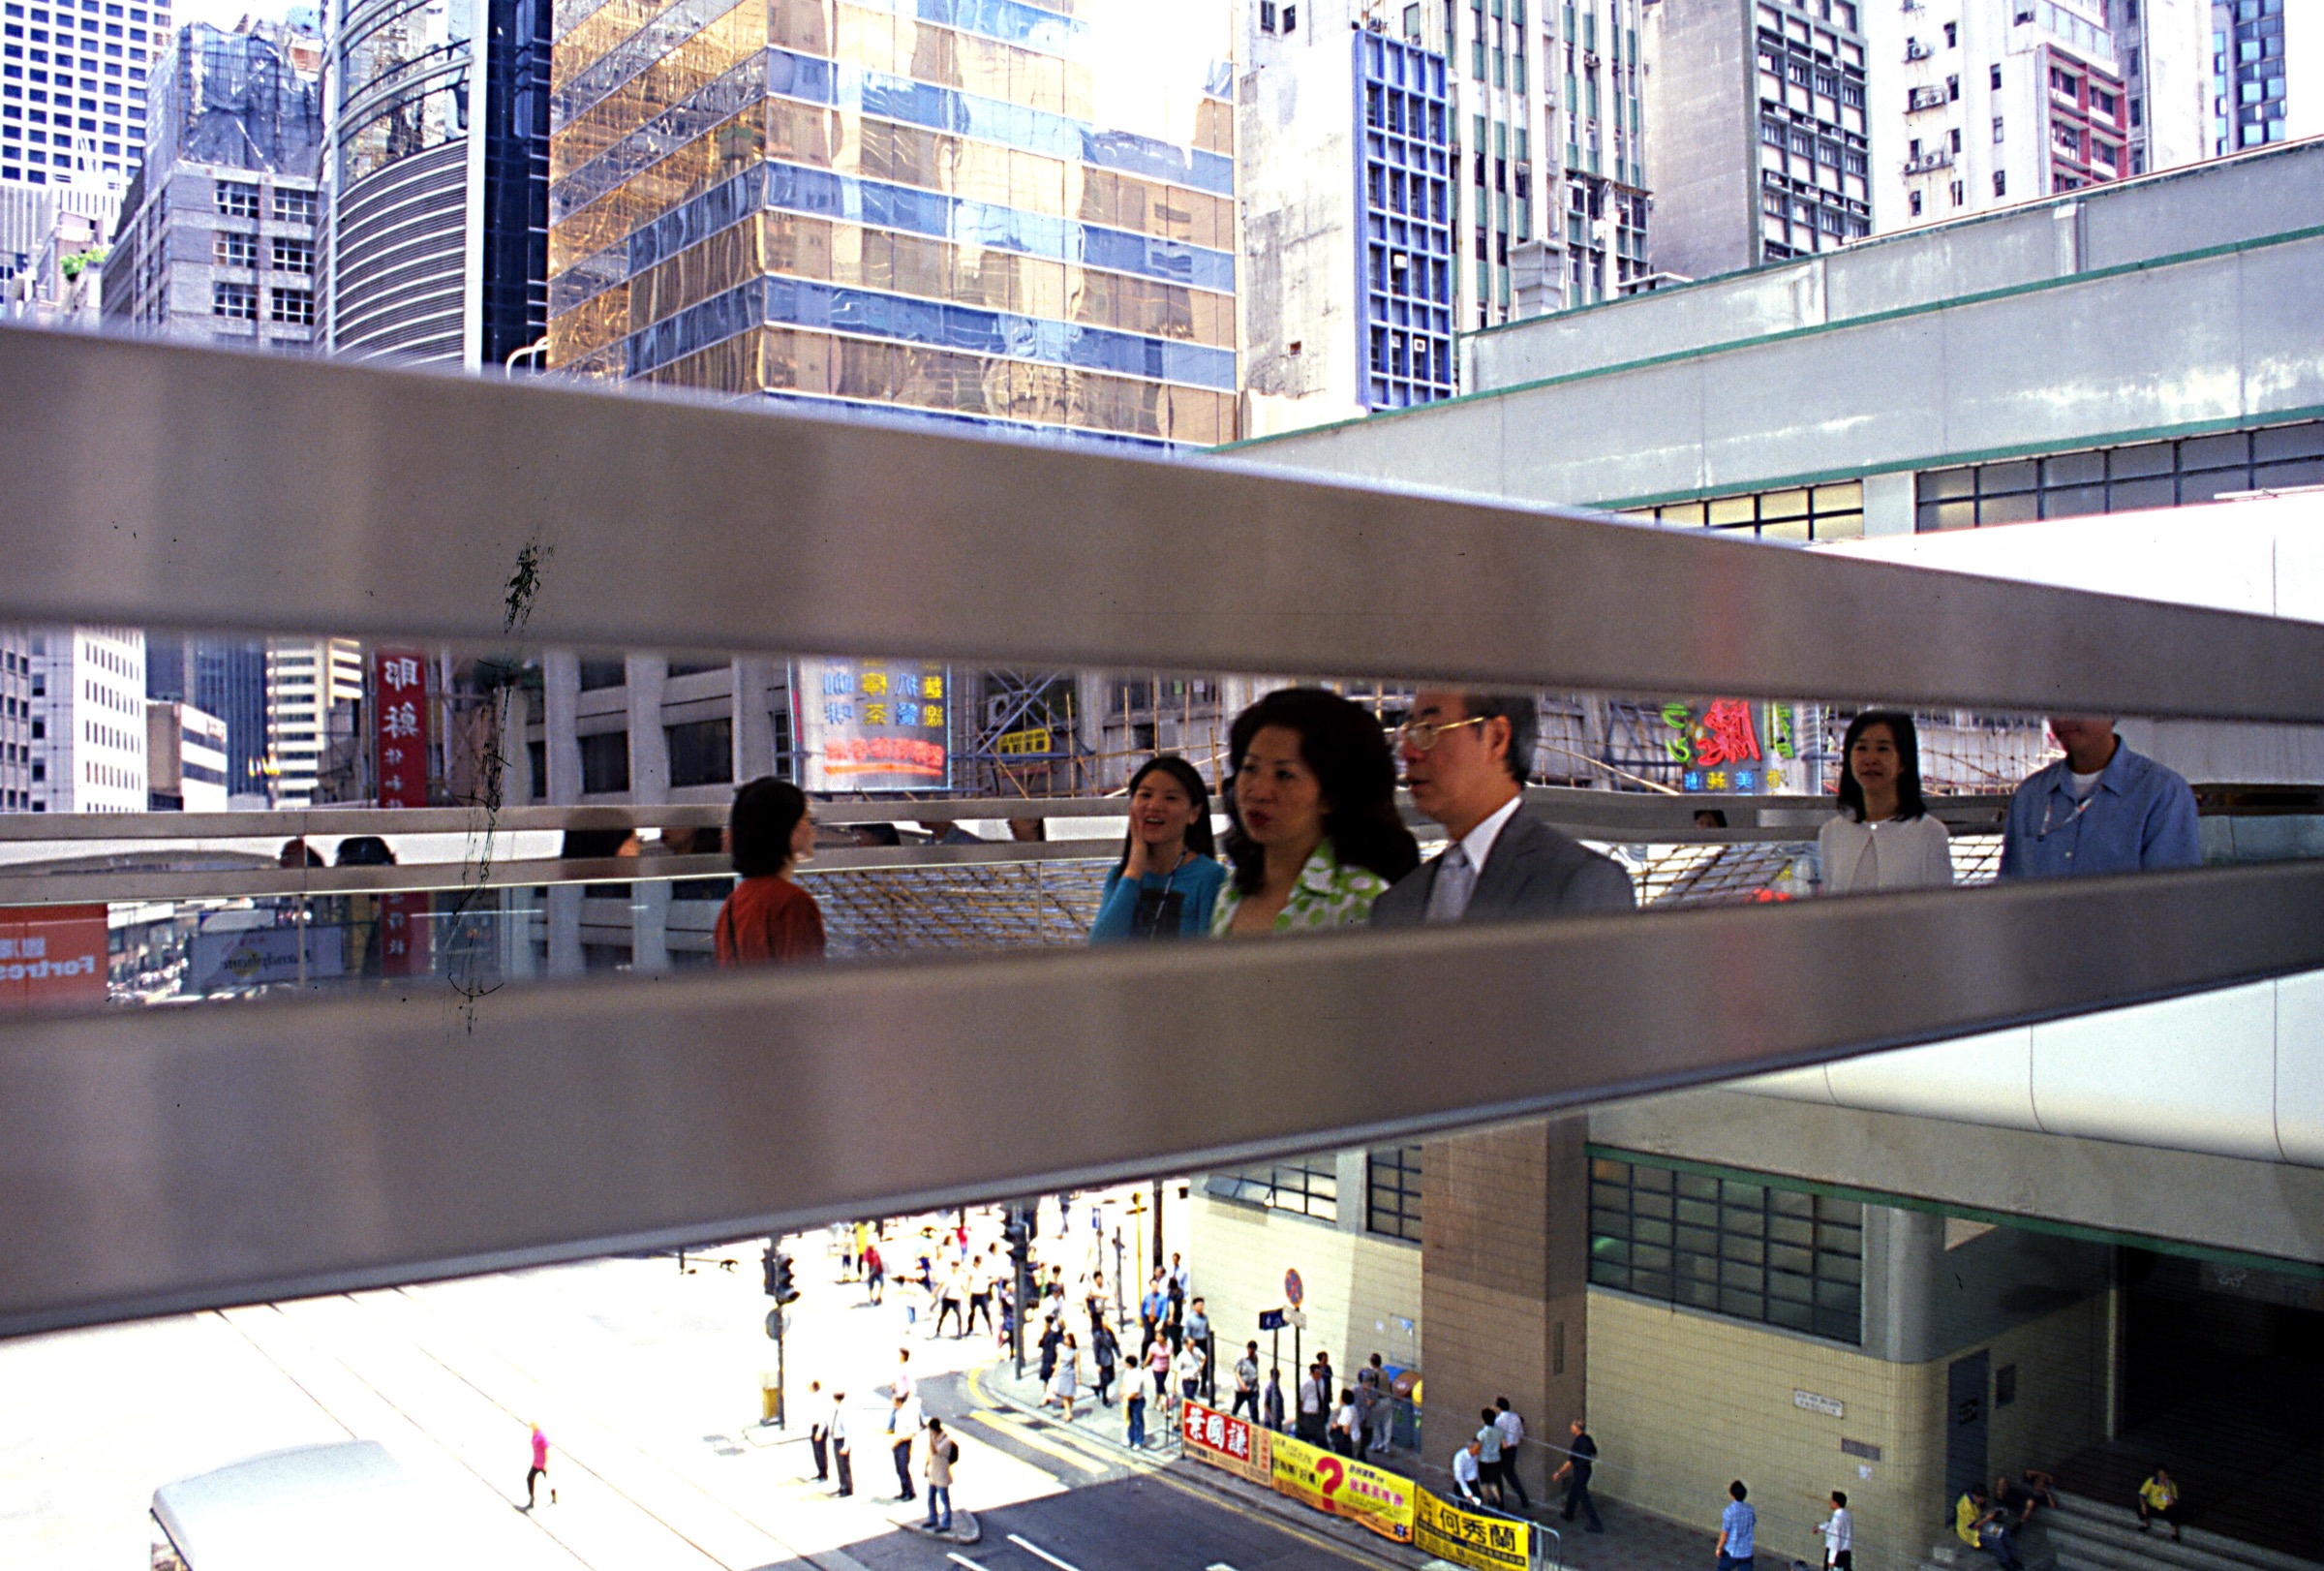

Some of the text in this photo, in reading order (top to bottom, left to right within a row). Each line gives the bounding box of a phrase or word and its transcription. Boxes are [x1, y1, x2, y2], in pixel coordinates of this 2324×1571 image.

[1185, 1406, 1248, 1458] 葉國謙
[1440, 1507, 1516, 1553] 何秀蘭
